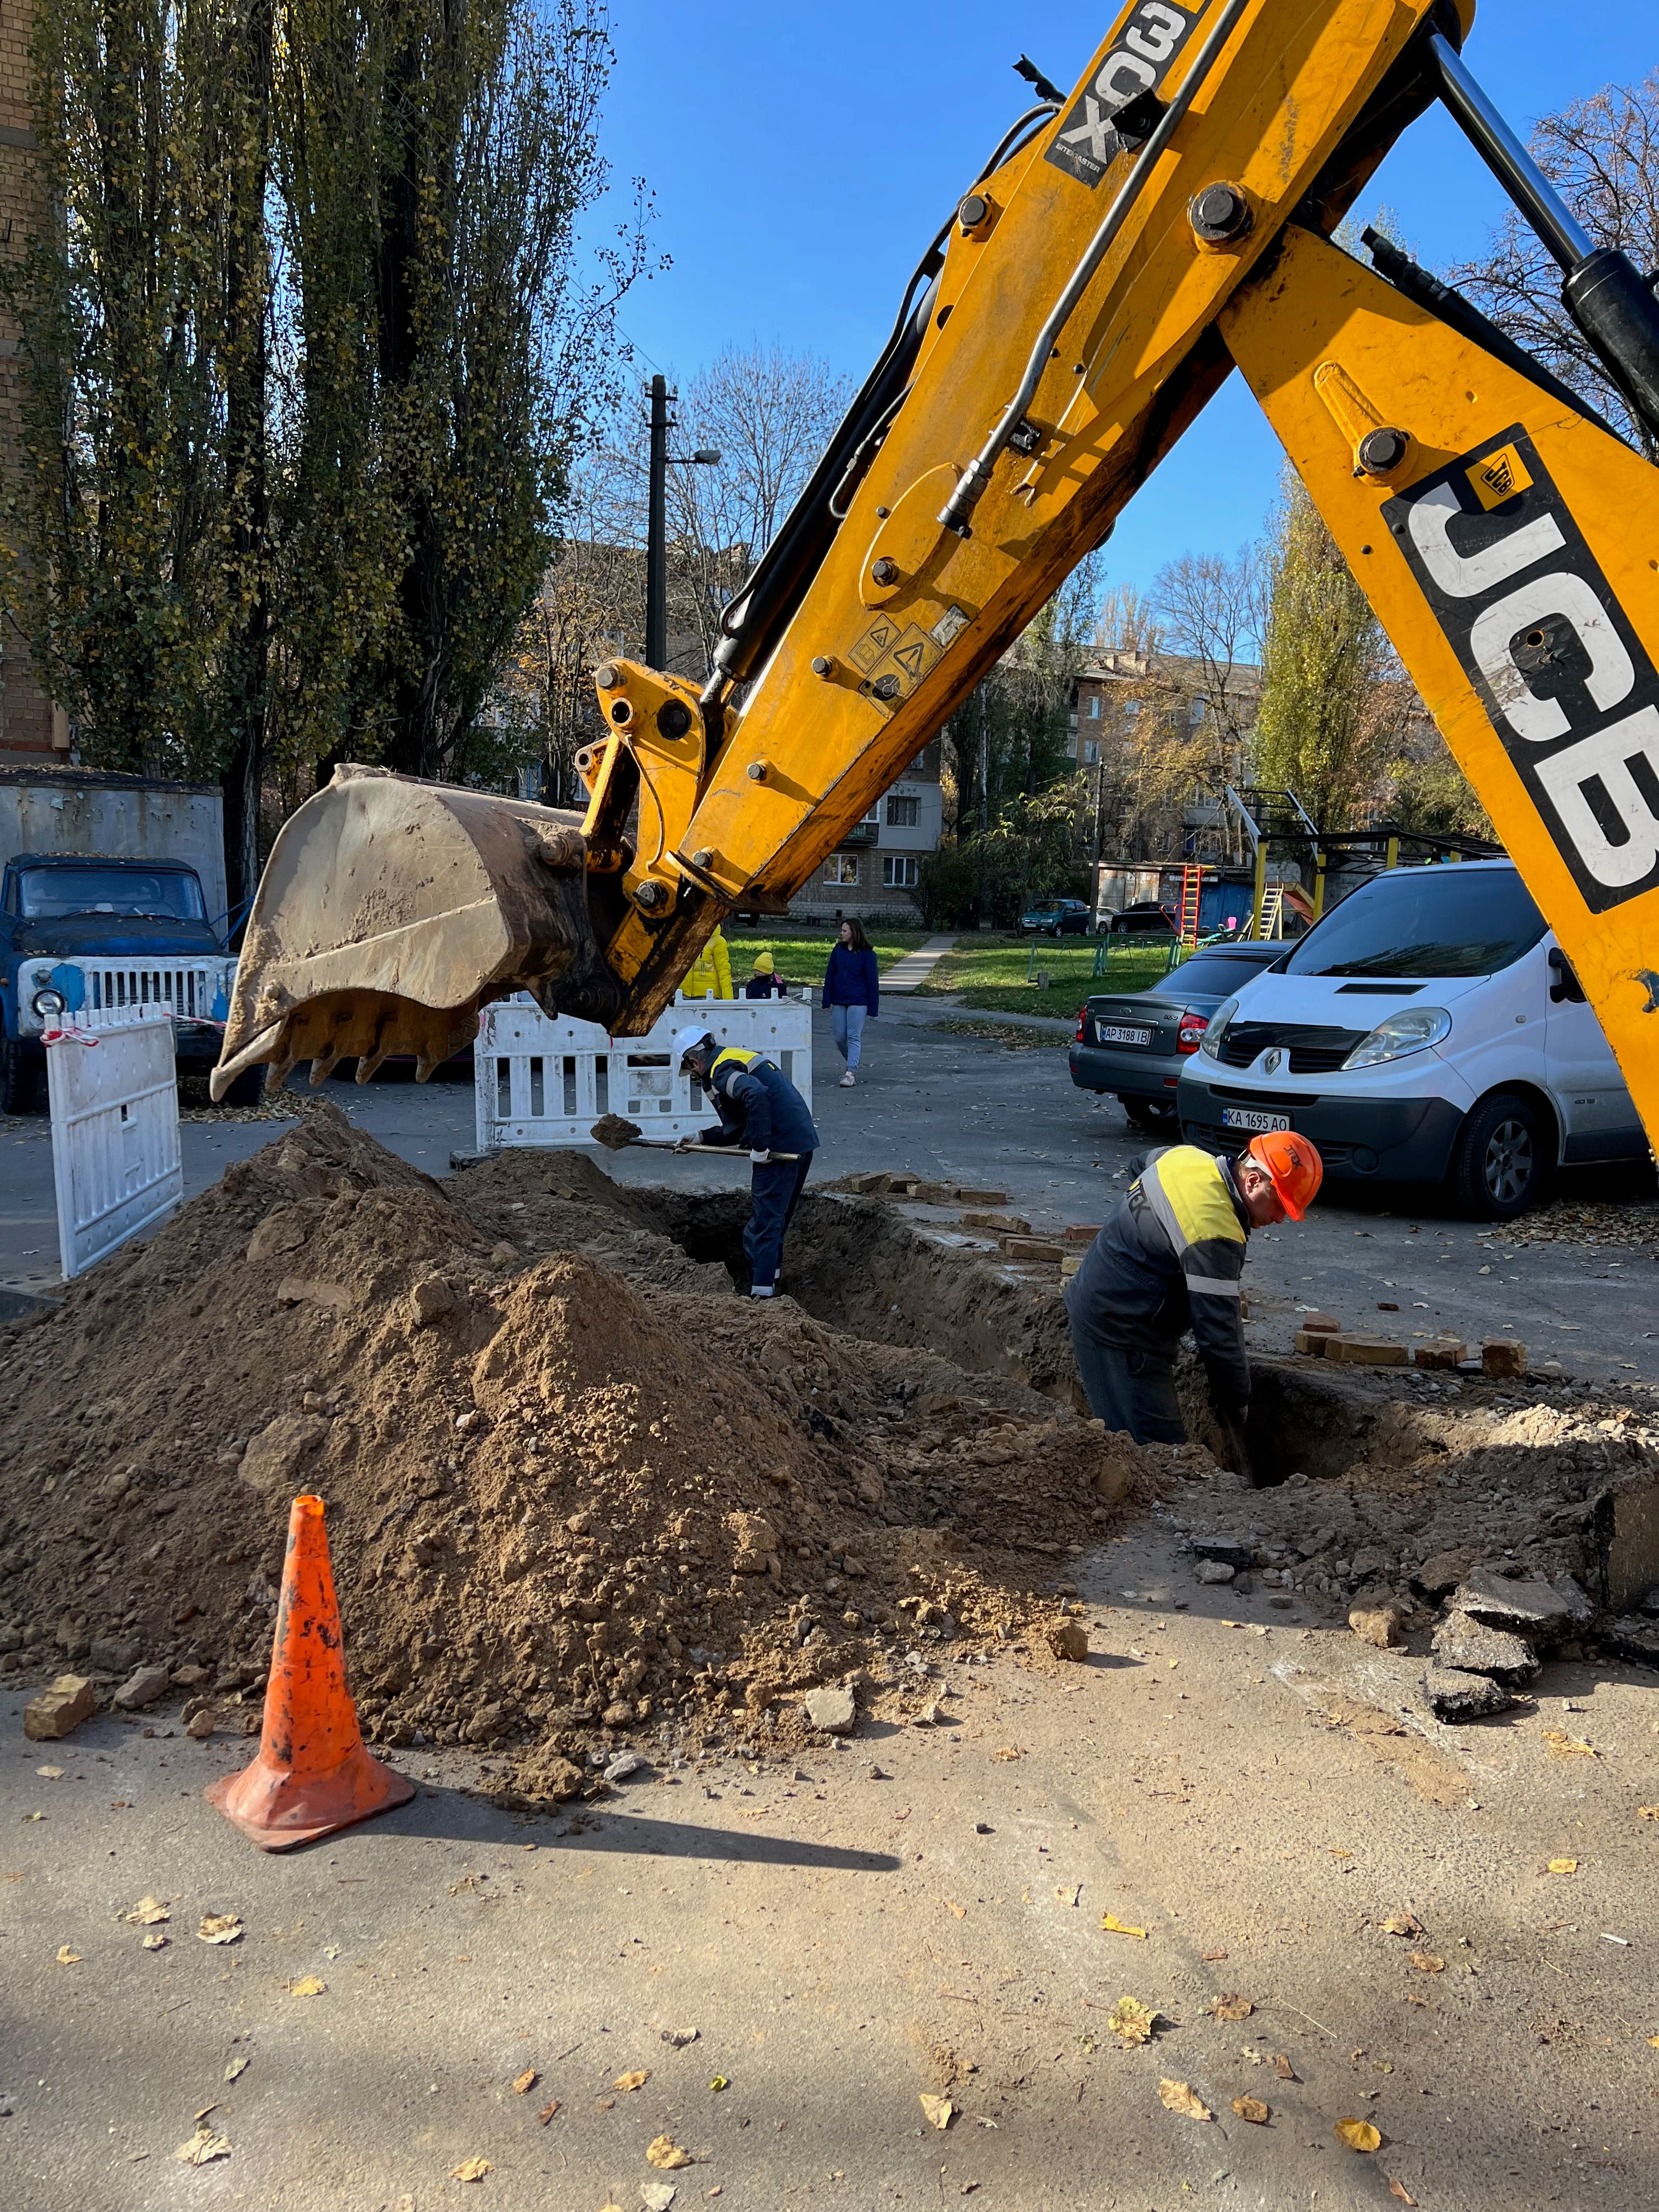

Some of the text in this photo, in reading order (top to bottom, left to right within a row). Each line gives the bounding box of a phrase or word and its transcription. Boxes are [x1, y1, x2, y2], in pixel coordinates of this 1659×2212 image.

[1485, 460, 1513, 493] JCB
[1408, 481, 1659, 887] JCB
[1105, 1028, 1117, 1040] AP
[1118, 1029, 1135, 1041] 3188
[1228, 1110, 1287, 1131] KA 1695 AO
